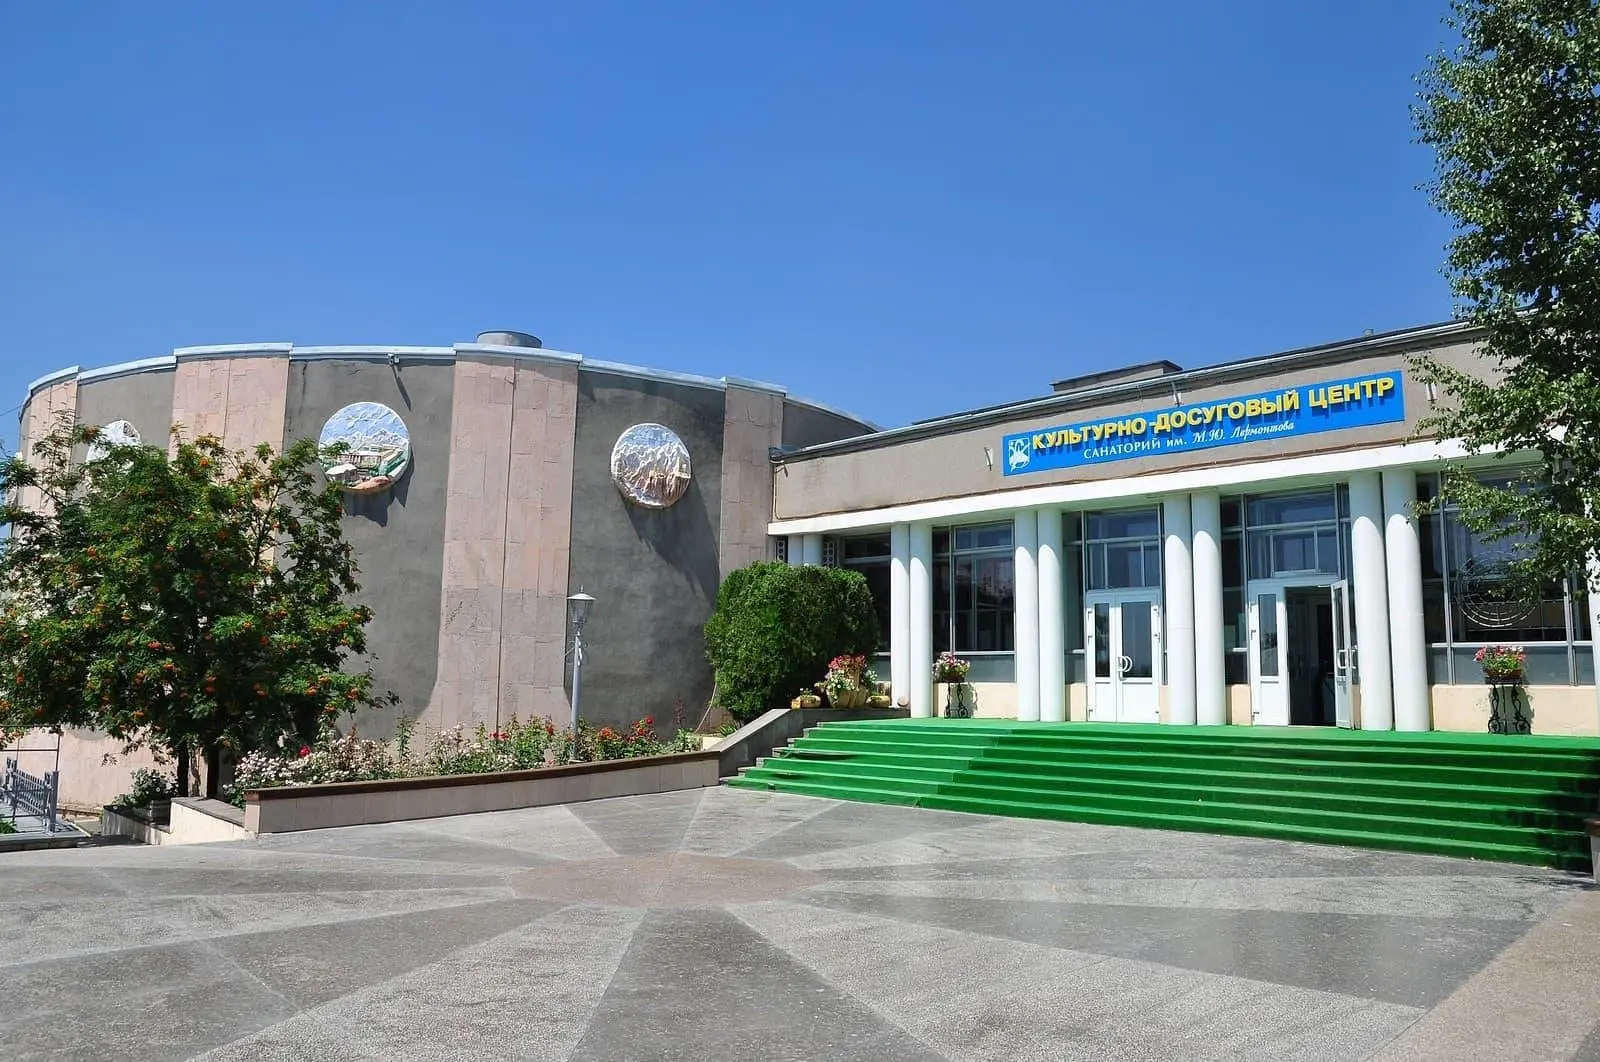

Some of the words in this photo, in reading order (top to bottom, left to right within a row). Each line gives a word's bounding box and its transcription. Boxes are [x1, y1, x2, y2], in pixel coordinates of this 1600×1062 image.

[1032, 389, 1300, 449] КУЛЬТУРНО-ДОСУГОВЫЙ
[1308, 377, 1394, 409] ЦЕНТР
[1083, 437, 1161, 459] САНАТОРИЙ
[1230, 420, 1295, 439] Лермонтова
